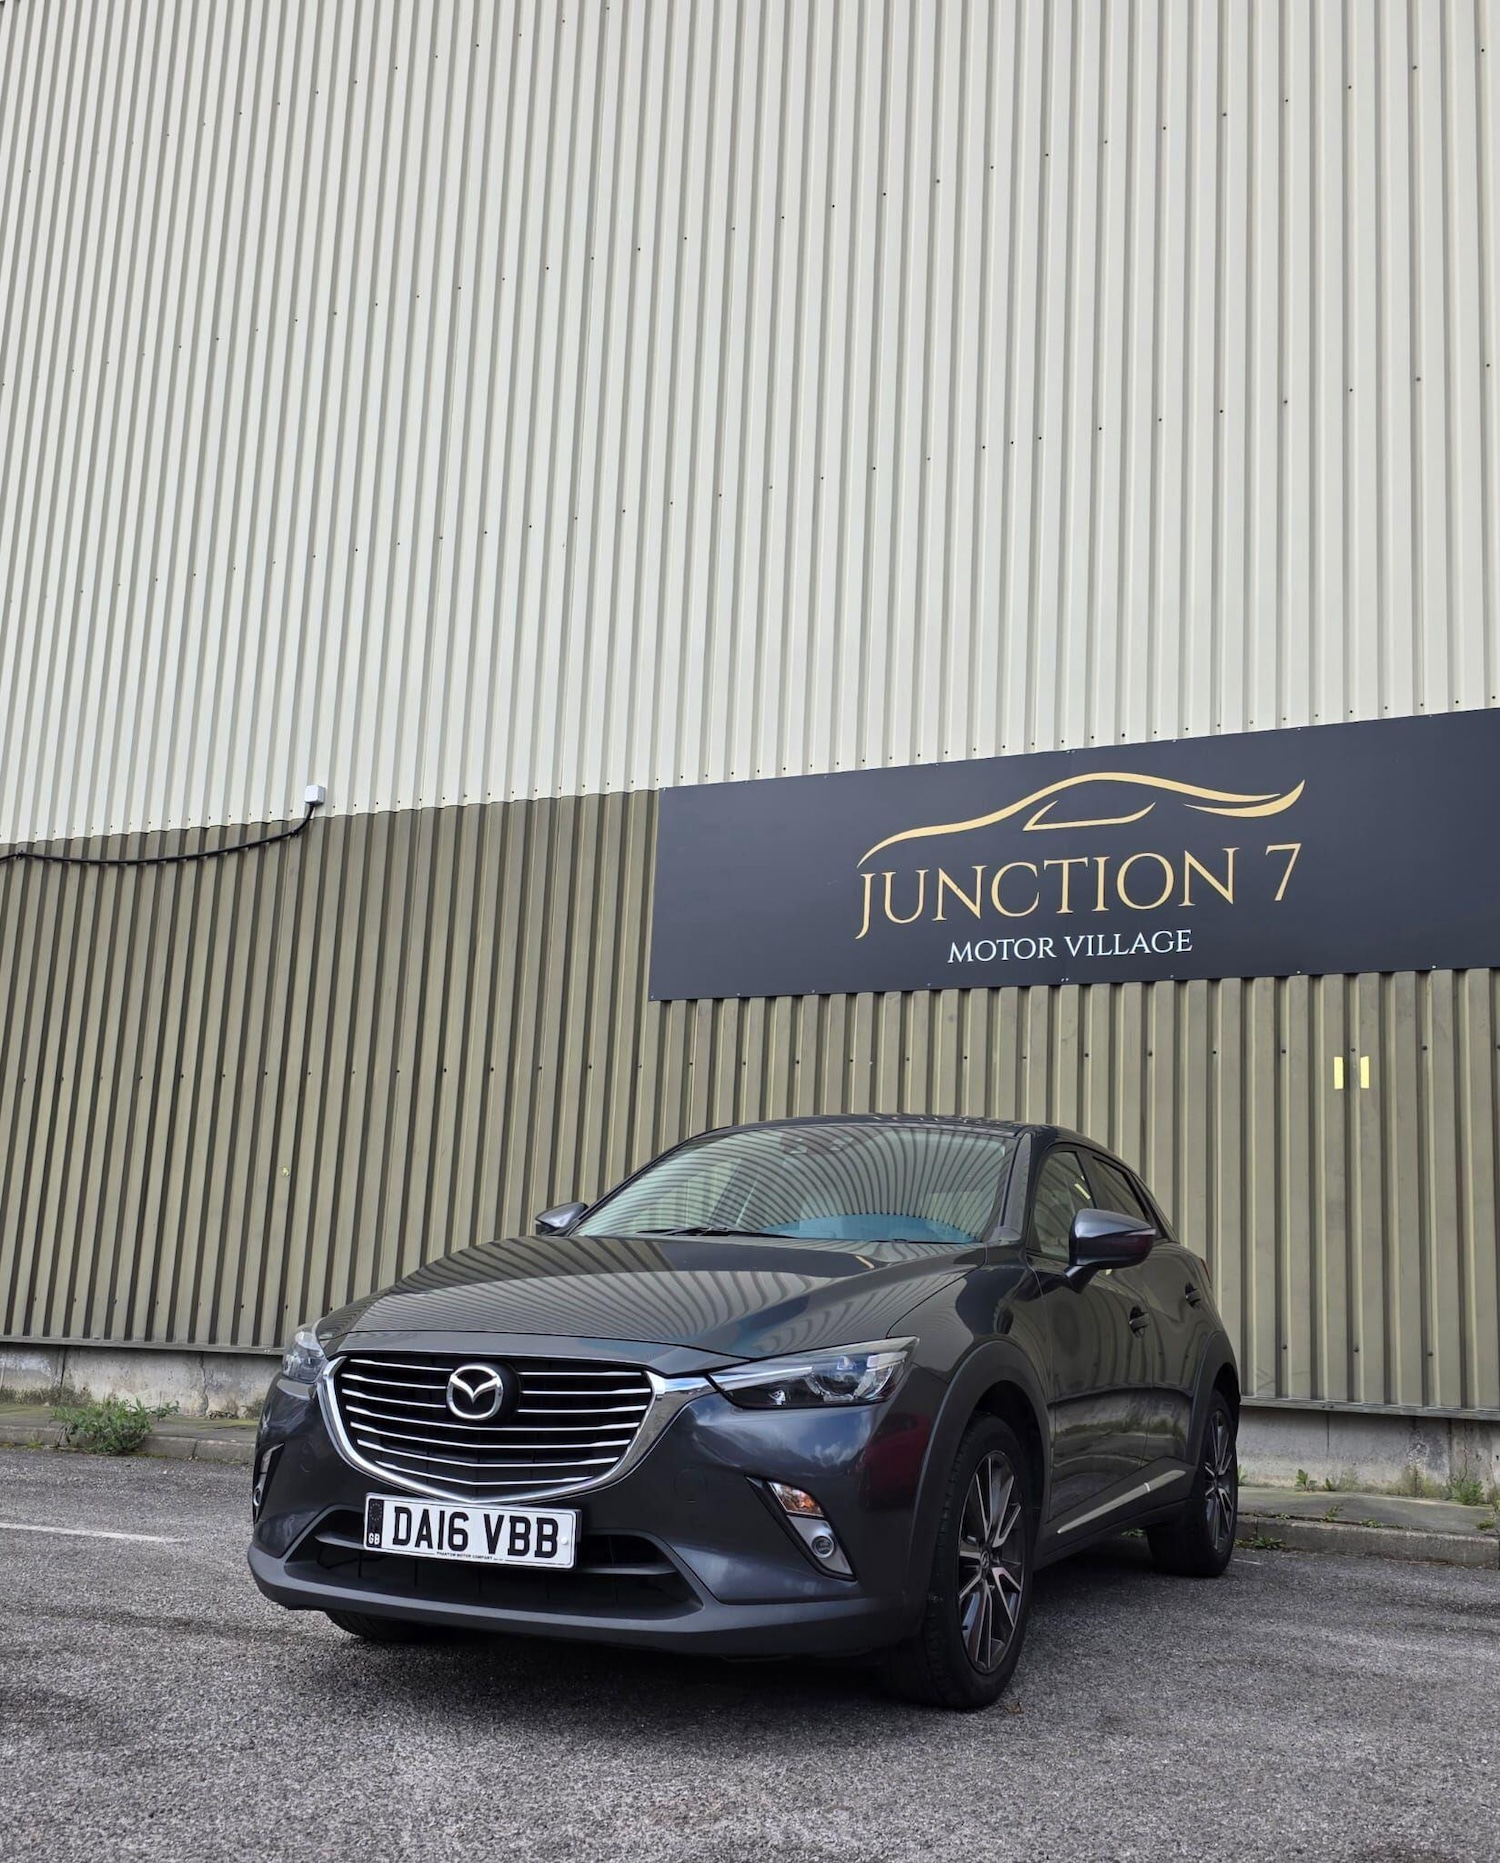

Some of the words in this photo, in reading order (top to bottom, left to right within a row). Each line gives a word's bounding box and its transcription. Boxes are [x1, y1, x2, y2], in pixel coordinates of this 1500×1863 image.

[855, 846, 1240, 940] JUNCTION
[1265, 843, 1302, 902] 7
[947, 936, 1057, 964] MOTOR
[1063, 929, 1194, 958] VILLAGE
[368, 1532, 381, 1545] GB
[392, 1506, 469, 1552] DA16
[483, 1513, 559, 1559] VBB
